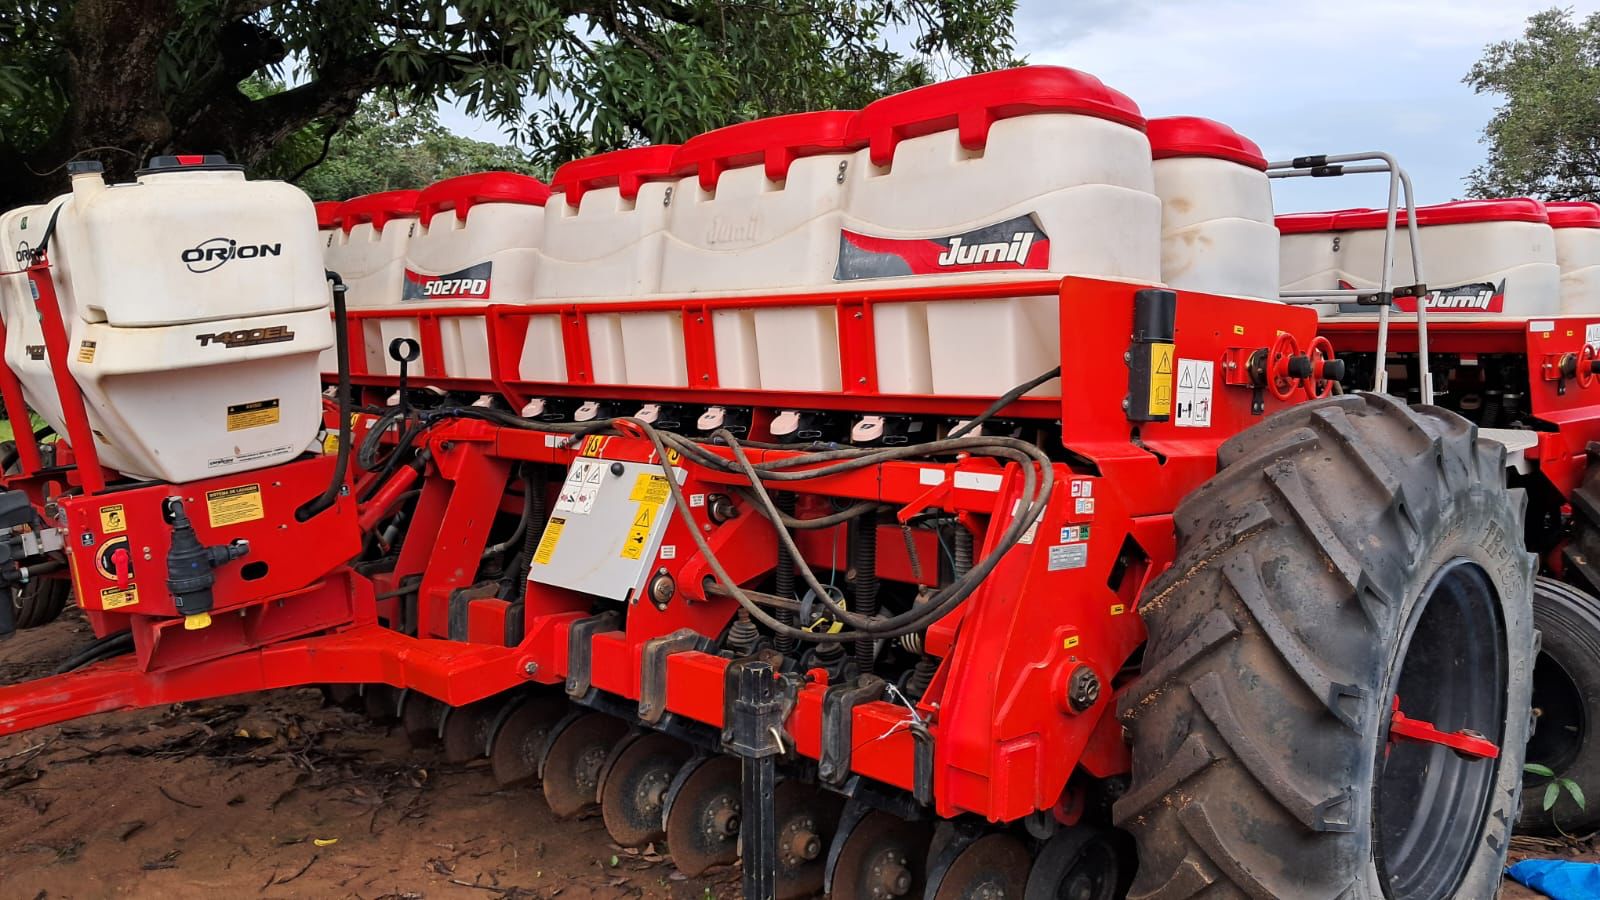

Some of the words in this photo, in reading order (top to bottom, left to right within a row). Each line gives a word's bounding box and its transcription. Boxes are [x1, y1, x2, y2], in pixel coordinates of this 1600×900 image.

[938, 232, 1035, 267] Jumil
[423, 279, 487, 296] 5027PD
[1424, 290, 1493, 310] Jumil
